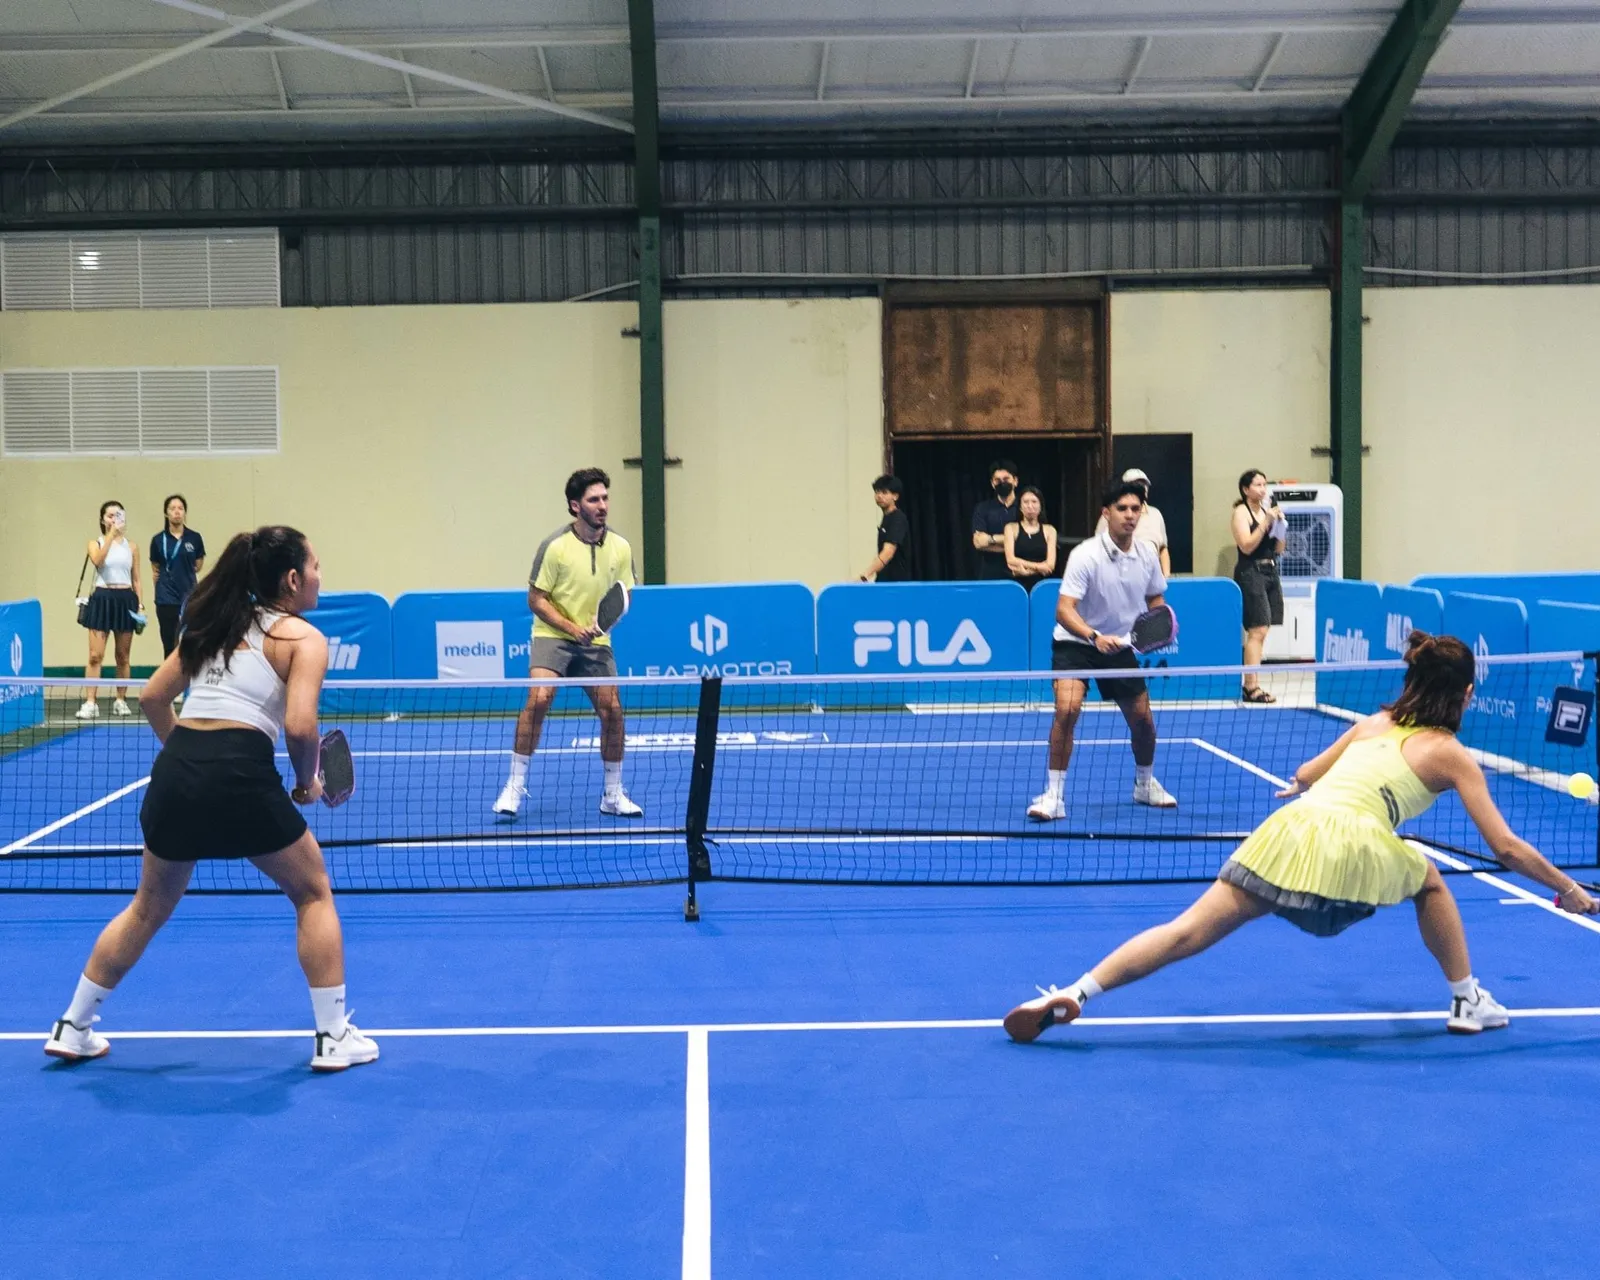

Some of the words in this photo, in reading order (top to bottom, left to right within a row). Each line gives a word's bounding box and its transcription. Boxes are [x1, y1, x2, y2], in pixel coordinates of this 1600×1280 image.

[444, 641, 497, 657] media
[508, 640, 531, 659] pri
[853, 618, 992, 667] FILA
[628, 660, 792, 678] LEAPMOTOR
